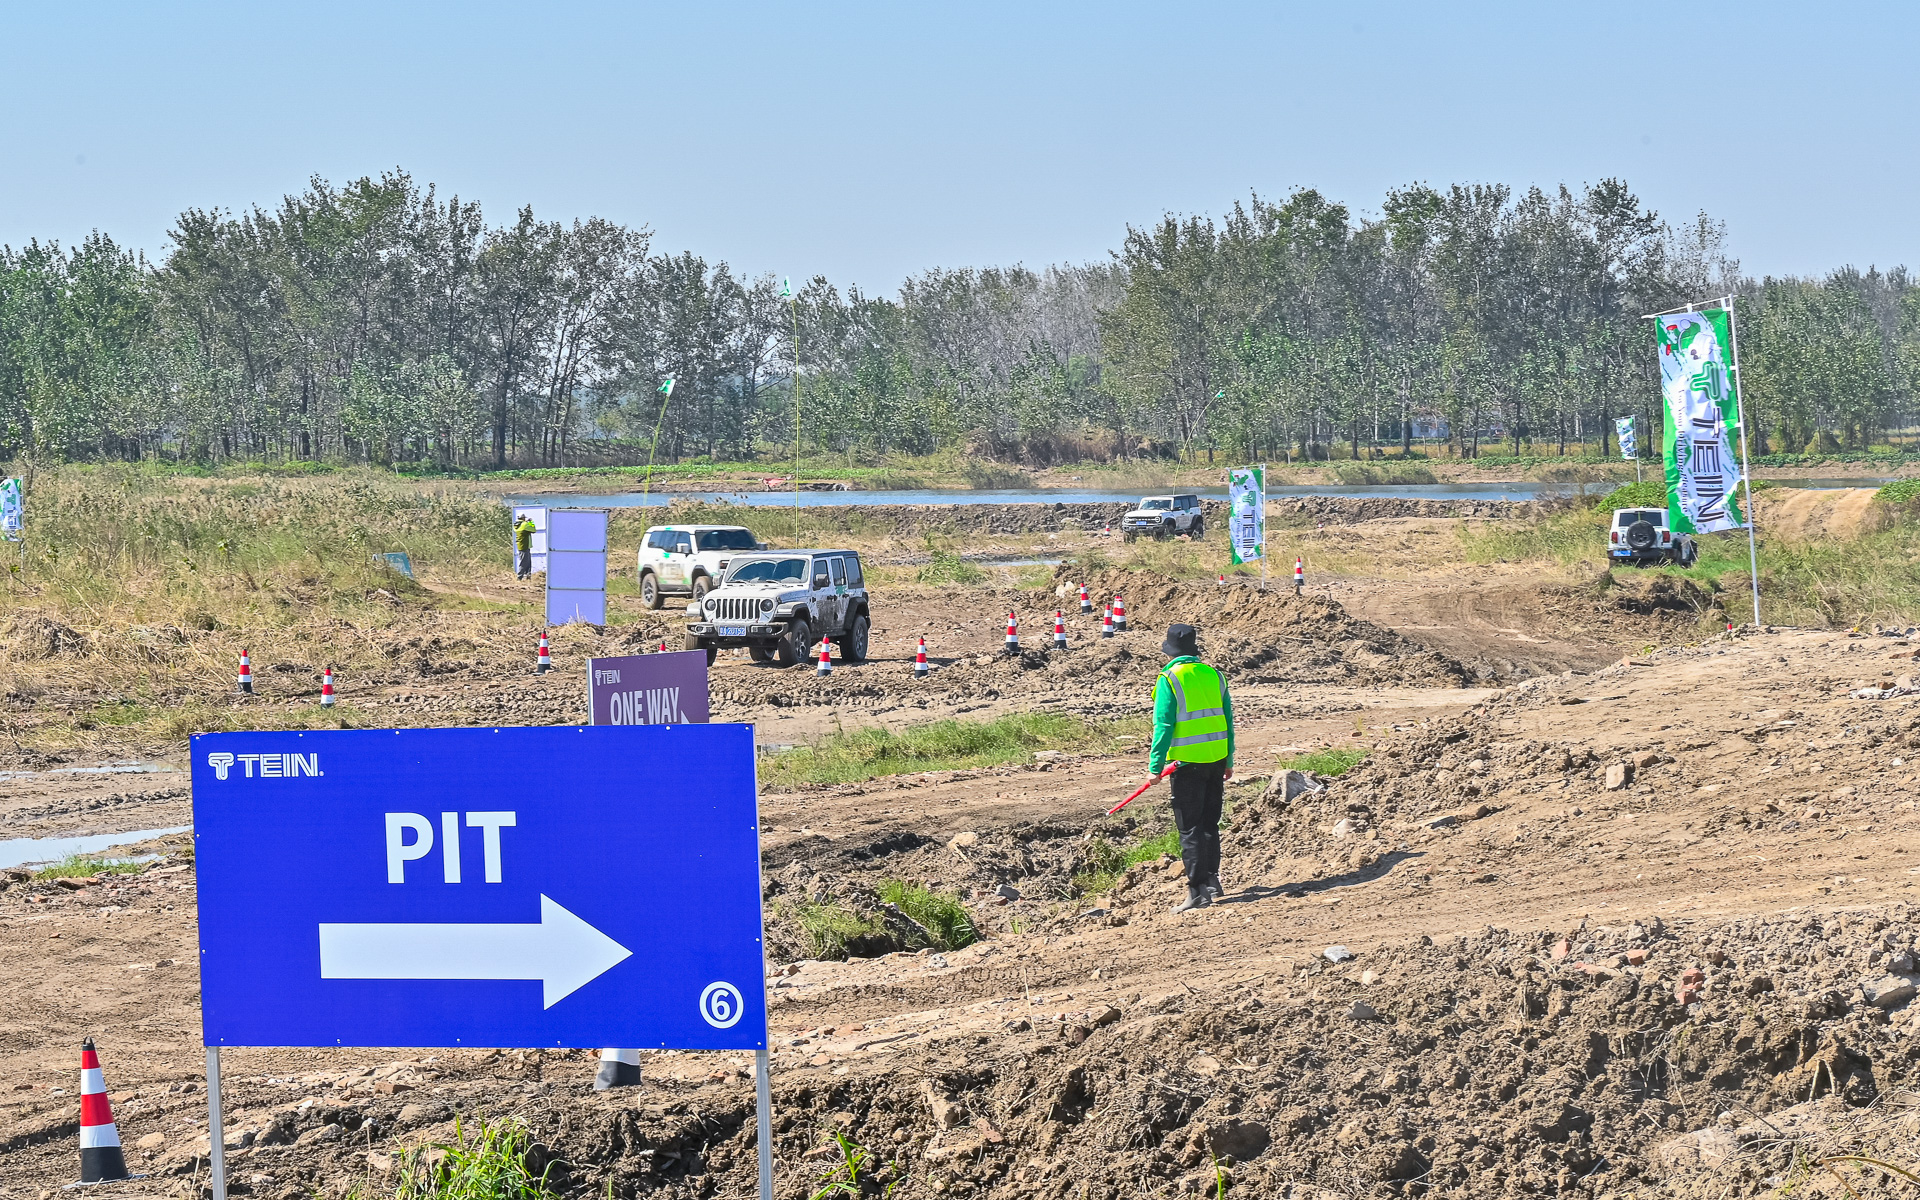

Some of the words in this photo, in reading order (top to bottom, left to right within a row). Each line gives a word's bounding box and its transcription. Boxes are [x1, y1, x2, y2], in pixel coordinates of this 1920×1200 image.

[1676, 430, 1688, 471] Driving
[1692, 407, 1725, 523] TEIN
[601, 669, 621, 685] TEIN
[610, 690, 644, 725] ONE
[646, 687, 680, 725] WAY
[236, 752, 319, 779] TEIN
[384, 811, 517, 884] PIT
[711, 988, 731, 1020] 6
